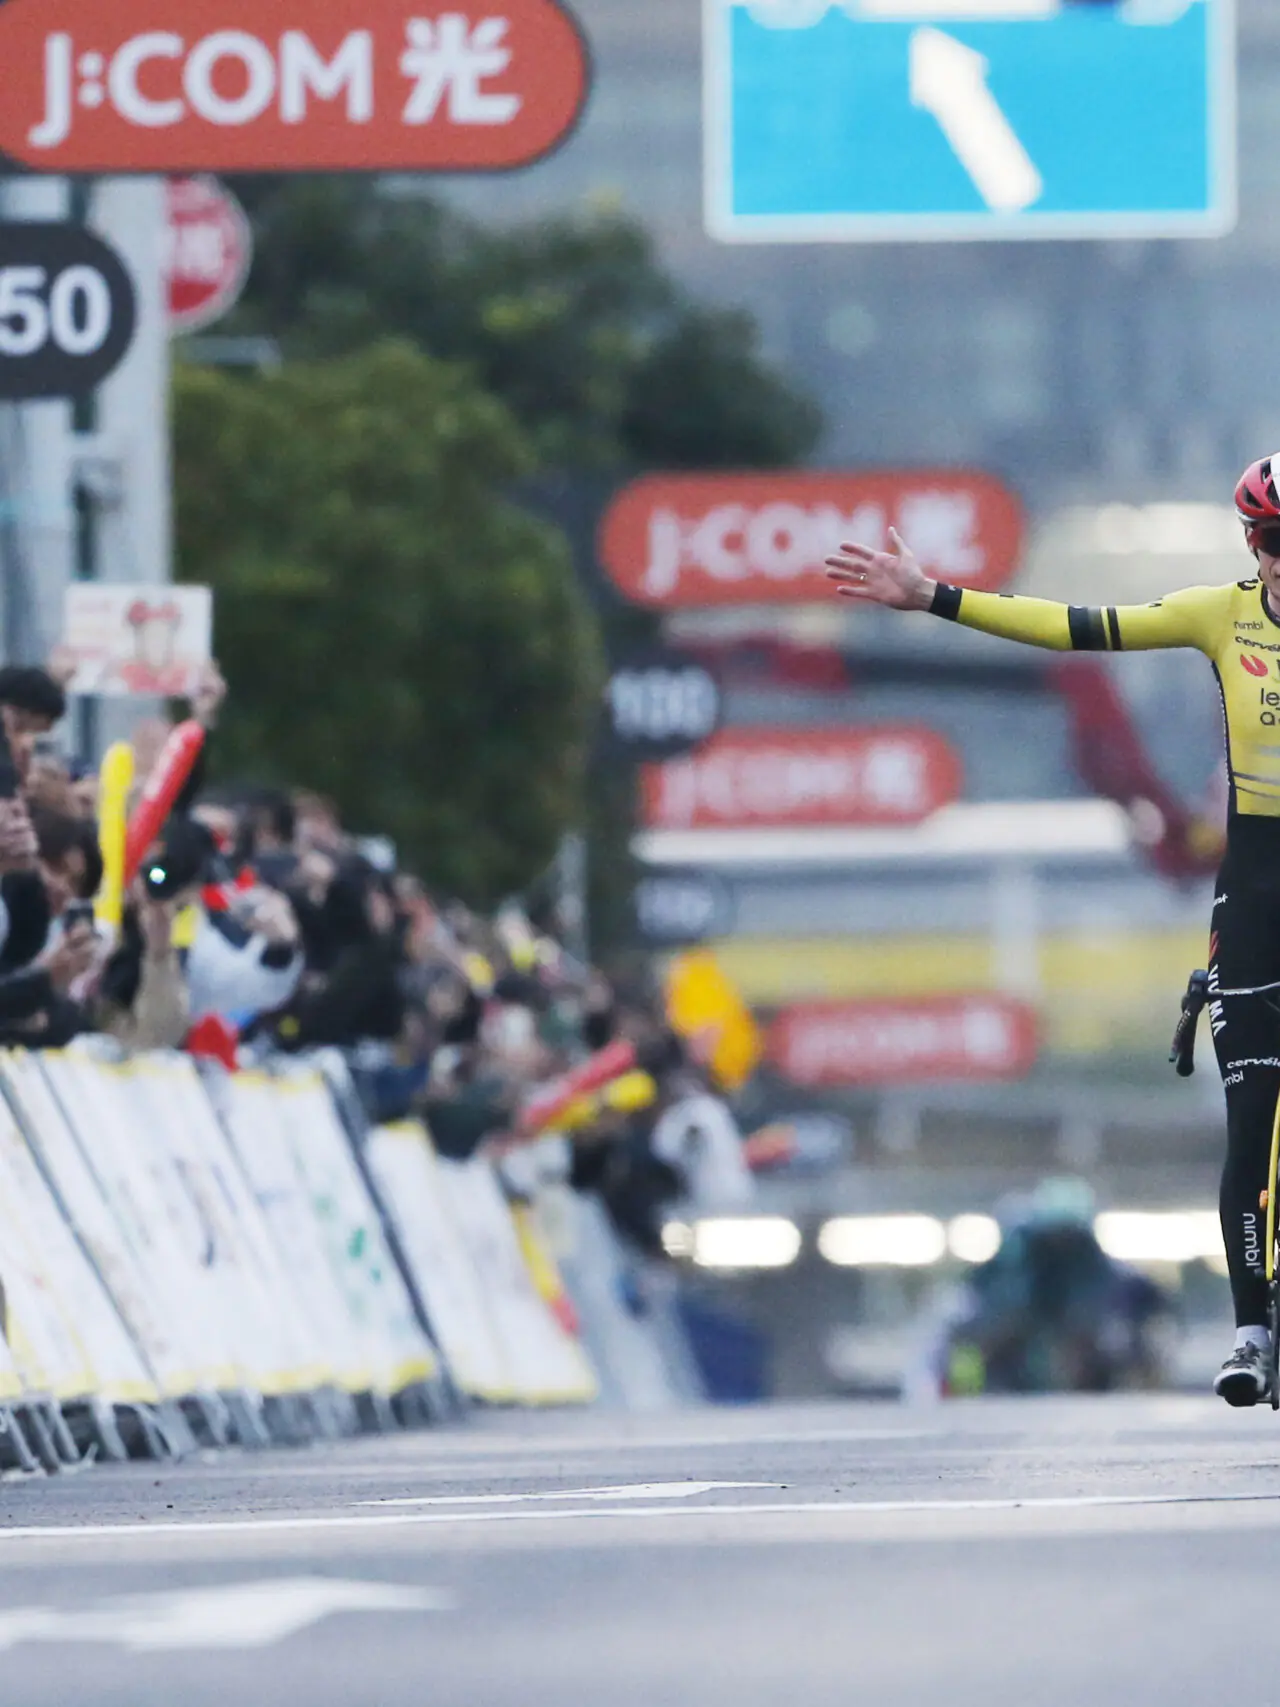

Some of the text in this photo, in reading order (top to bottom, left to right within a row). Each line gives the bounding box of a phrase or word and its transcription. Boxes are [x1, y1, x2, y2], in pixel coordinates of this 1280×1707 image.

[28, 13, 521, 148] J:COM 光
[0, 263, 112, 355] 50
[1224, 1070, 1244, 1087] mbl
[1242, 1213, 1261, 1266] nimbl
